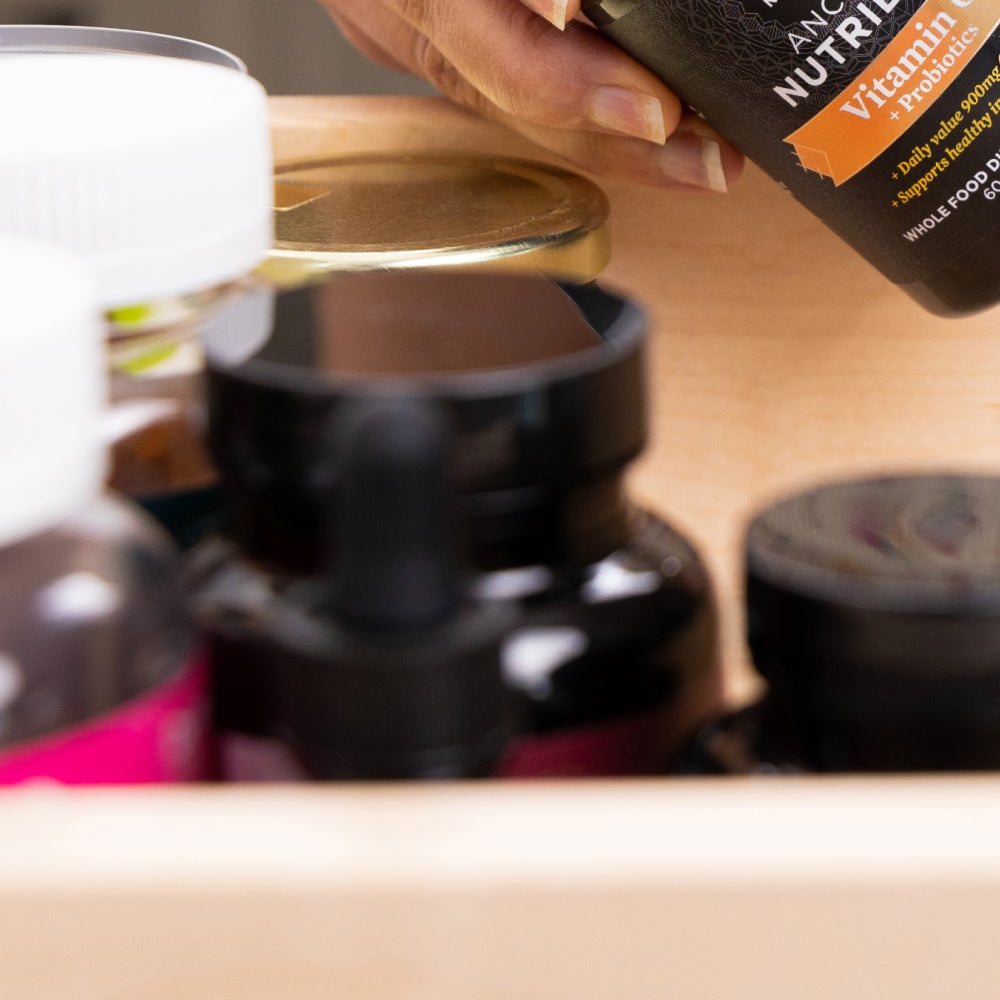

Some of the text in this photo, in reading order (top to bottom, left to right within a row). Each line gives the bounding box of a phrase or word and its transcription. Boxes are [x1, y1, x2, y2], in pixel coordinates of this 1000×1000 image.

[840, 11, 957, 120] Vitamin
[897, 24, 979, 112] Probiotics
[897, 142, 932, 176] Daily
[930, 109, 964, 146] value
[897, 159, 949, 204] Supports
[946, 112, 993, 161] healthy
[903, 205, 951, 242] WHOLE
[947, 170, 988, 209] FOOD
